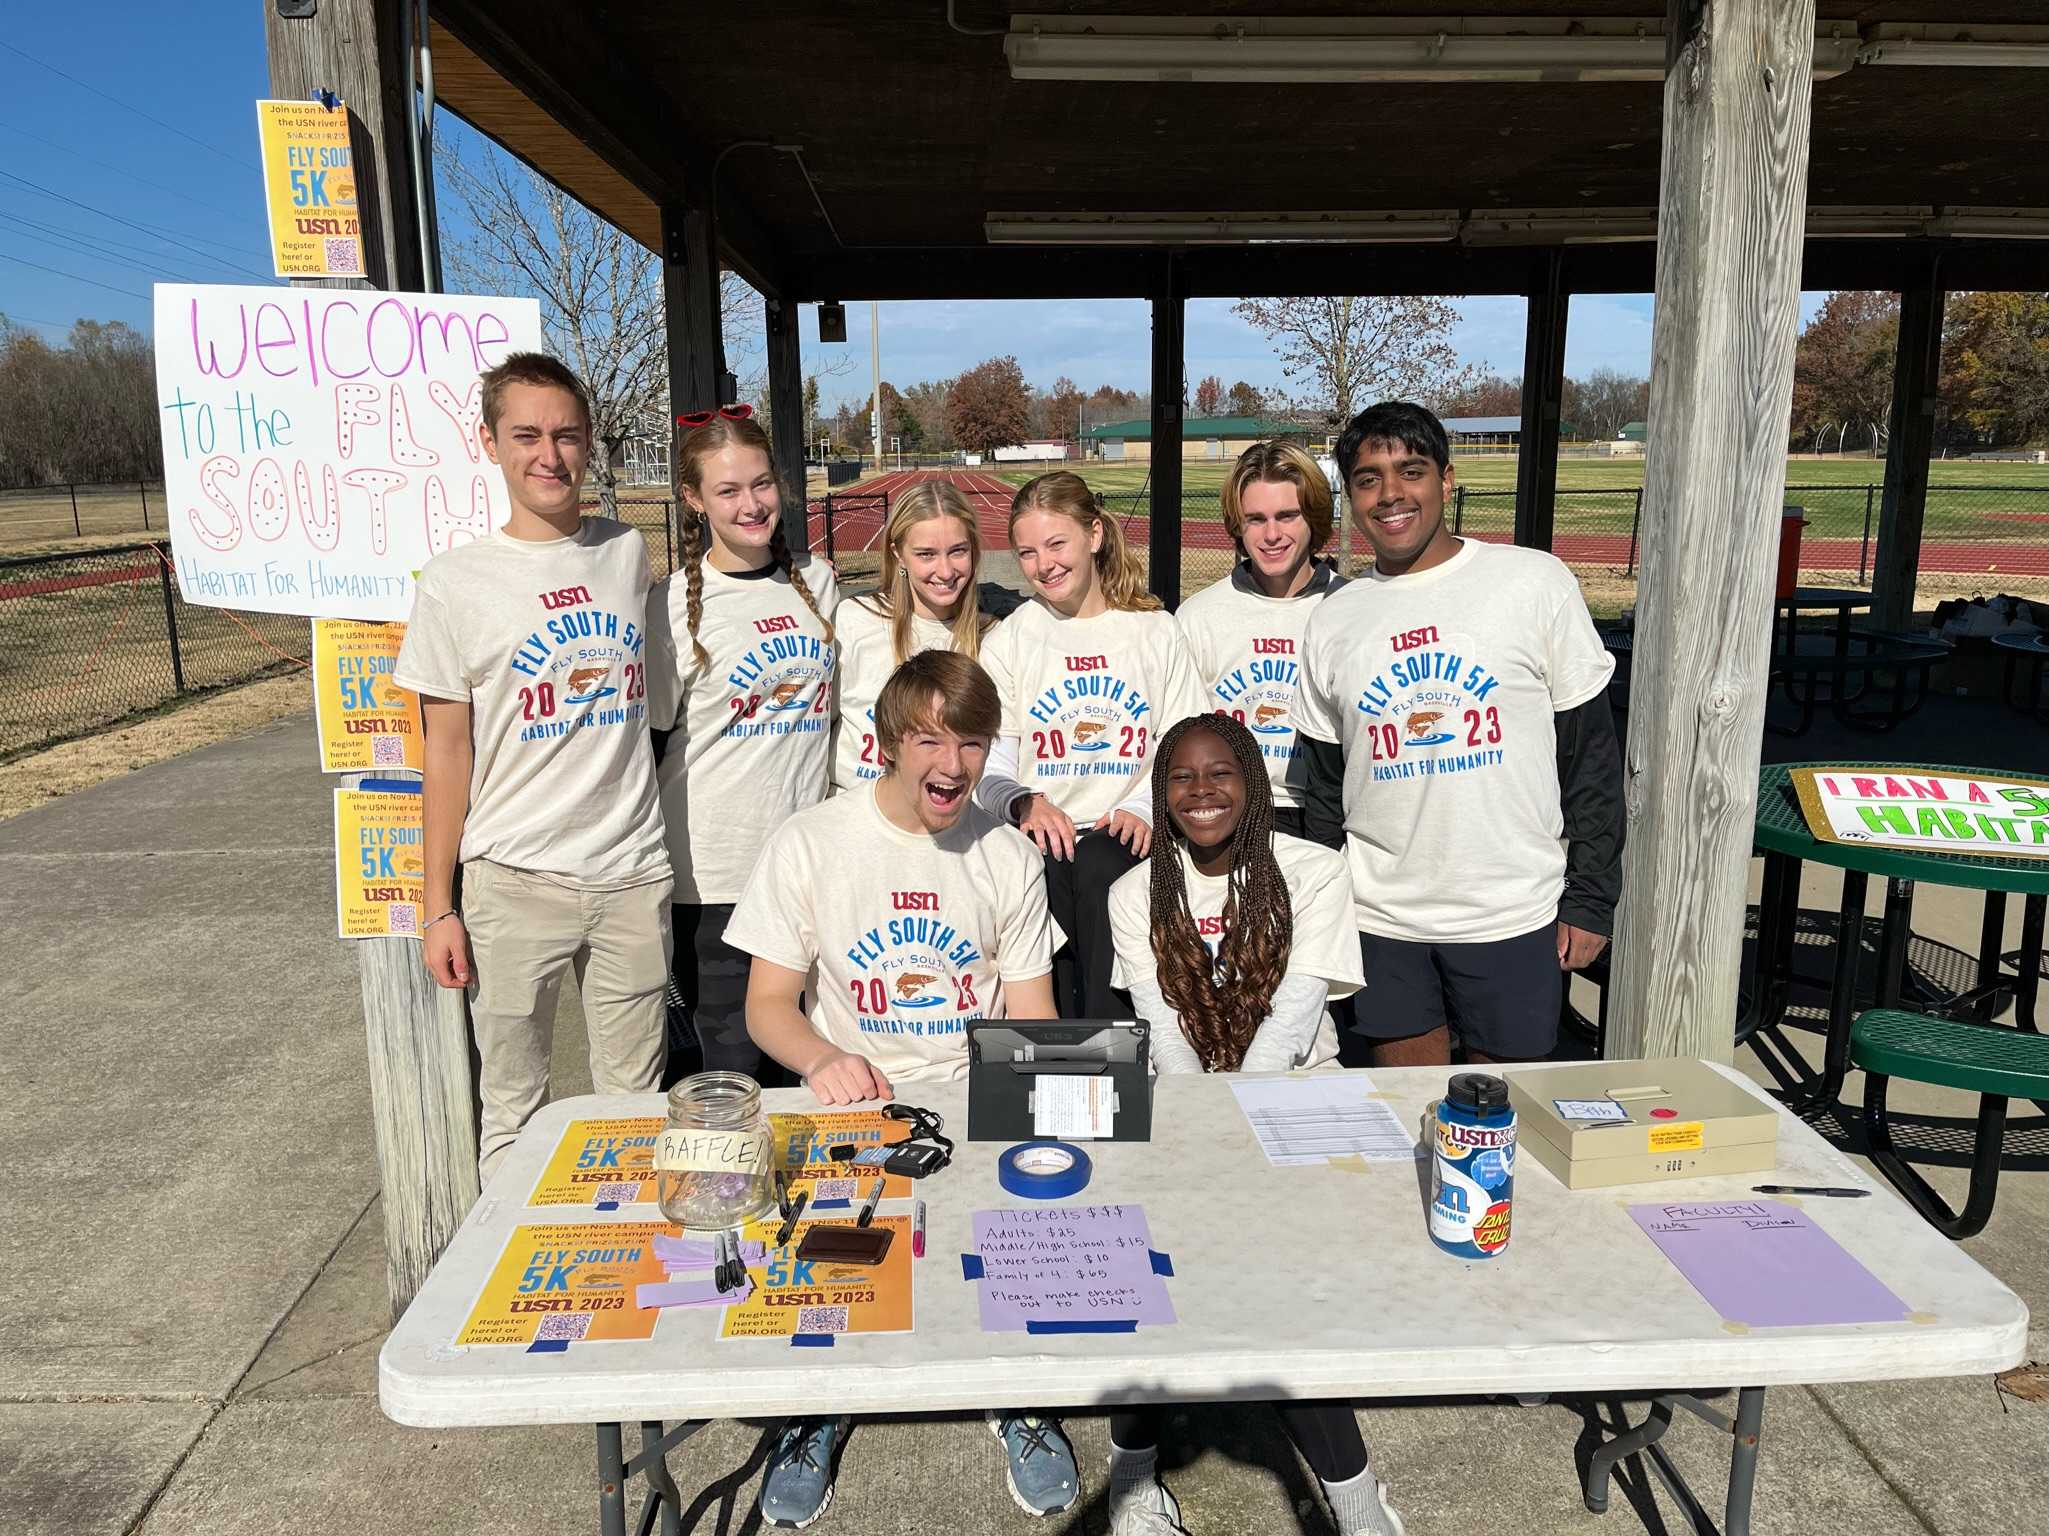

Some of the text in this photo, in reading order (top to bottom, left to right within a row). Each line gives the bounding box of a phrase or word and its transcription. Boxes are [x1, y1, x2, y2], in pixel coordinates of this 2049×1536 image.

[288, 146, 314, 167] FLY
[290, 170, 330, 207] 5K
[296, 218, 341, 234] usn
[282, 242, 316, 250] Register
[283, 264, 320, 272] USN.ORG
[164, 381, 483, 467] to the FLY
[189, 454, 491, 556] SOUTH
[538, 585, 592, 610] usn
[753, 615, 799, 634] usn
[512, 611, 644, 677] FLY SOUTH 5K
[1252, 638, 1296, 654] usn
[1390, 624, 1440, 652] usn
[338, 656, 364, 674] FLY
[550, 648, 623, 672] FLY SOUTH
[728, 636, 820, 690] FLY SOUTH
[1065, 655, 1109, 672] usn
[340, 676, 378, 710] 5K
[518, 662, 645, 721] 20 23
[1216, 669, 1247, 703] FLY
[1358, 652, 1499, 716] FLY SOUTH 5K
[1029, 676, 1150, 724] FLY SOUTH 5K
[1392, 692, 1461, 715] FLY SOUTH
[1060, 706, 1122, 724] FLY SOUTH
[344, 718, 412, 734] usn 2023
[770, 722, 790, 735] FOR
[1368, 706, 1501, 760] 20 23
[331, 741, 363, 749] Register
[1032, 726, 1147, 759] 20 23
[1038, 763, 1090, 776] HABITAT FOR
[1374, 763, 1415, 780] HABITAT
[1438, 750, 1503, 774] HUMANITY
[1824, 777, 1840, 796] I
[1852, 776, 1949, 800] RAN
[1969, 782, 1990, 804] A
[360, 828, 384, 845] FLY
[362, 847, 397, 878] 5K
[363, 888, 406, 901] usn
[891, 891, 939, 911] usn
[848, 916, 980, 970] FLY SOUTH 5K
[882, 957, 904, 972] FLY
[850, 973, 978, 1014] 20 23
[860, 1018, 903, 1034] HABITAT
[585, 1138, 618, 1149] FLY
[789, 1131, 880, 1144] FLY SOUTH
[576, 1148, 625, 1168] 5K
[664, 1136, 763, 1163] RAFFLE!
[787, 1144, 831, 1164] 5K
[570, 1172, 624, 1183] usn
[786, 1167, 880, 1179] usn 2023
[1116, 1236, 1145, 1248] $15
[530, 1248, 642, 1265] FLY SOUTH
[984, 1256, 1026, 1266] Lower
[1083, 1254, 1109, 1264] $10
[518, 1265, 578, 1293] 5K
[766, 1260, 815, 1286] 5K
[986, 1271, 1028, 1280] Family
[764, 1291, 875, 1306] usn 2023
[991, 1288, 1136, 1301] Please make checks
[1088, 1298, 1124, 1308] USN
[510, 1297, 625, 1313] usn 2023
[466, 1336, 523, 1344] USN.ORG
